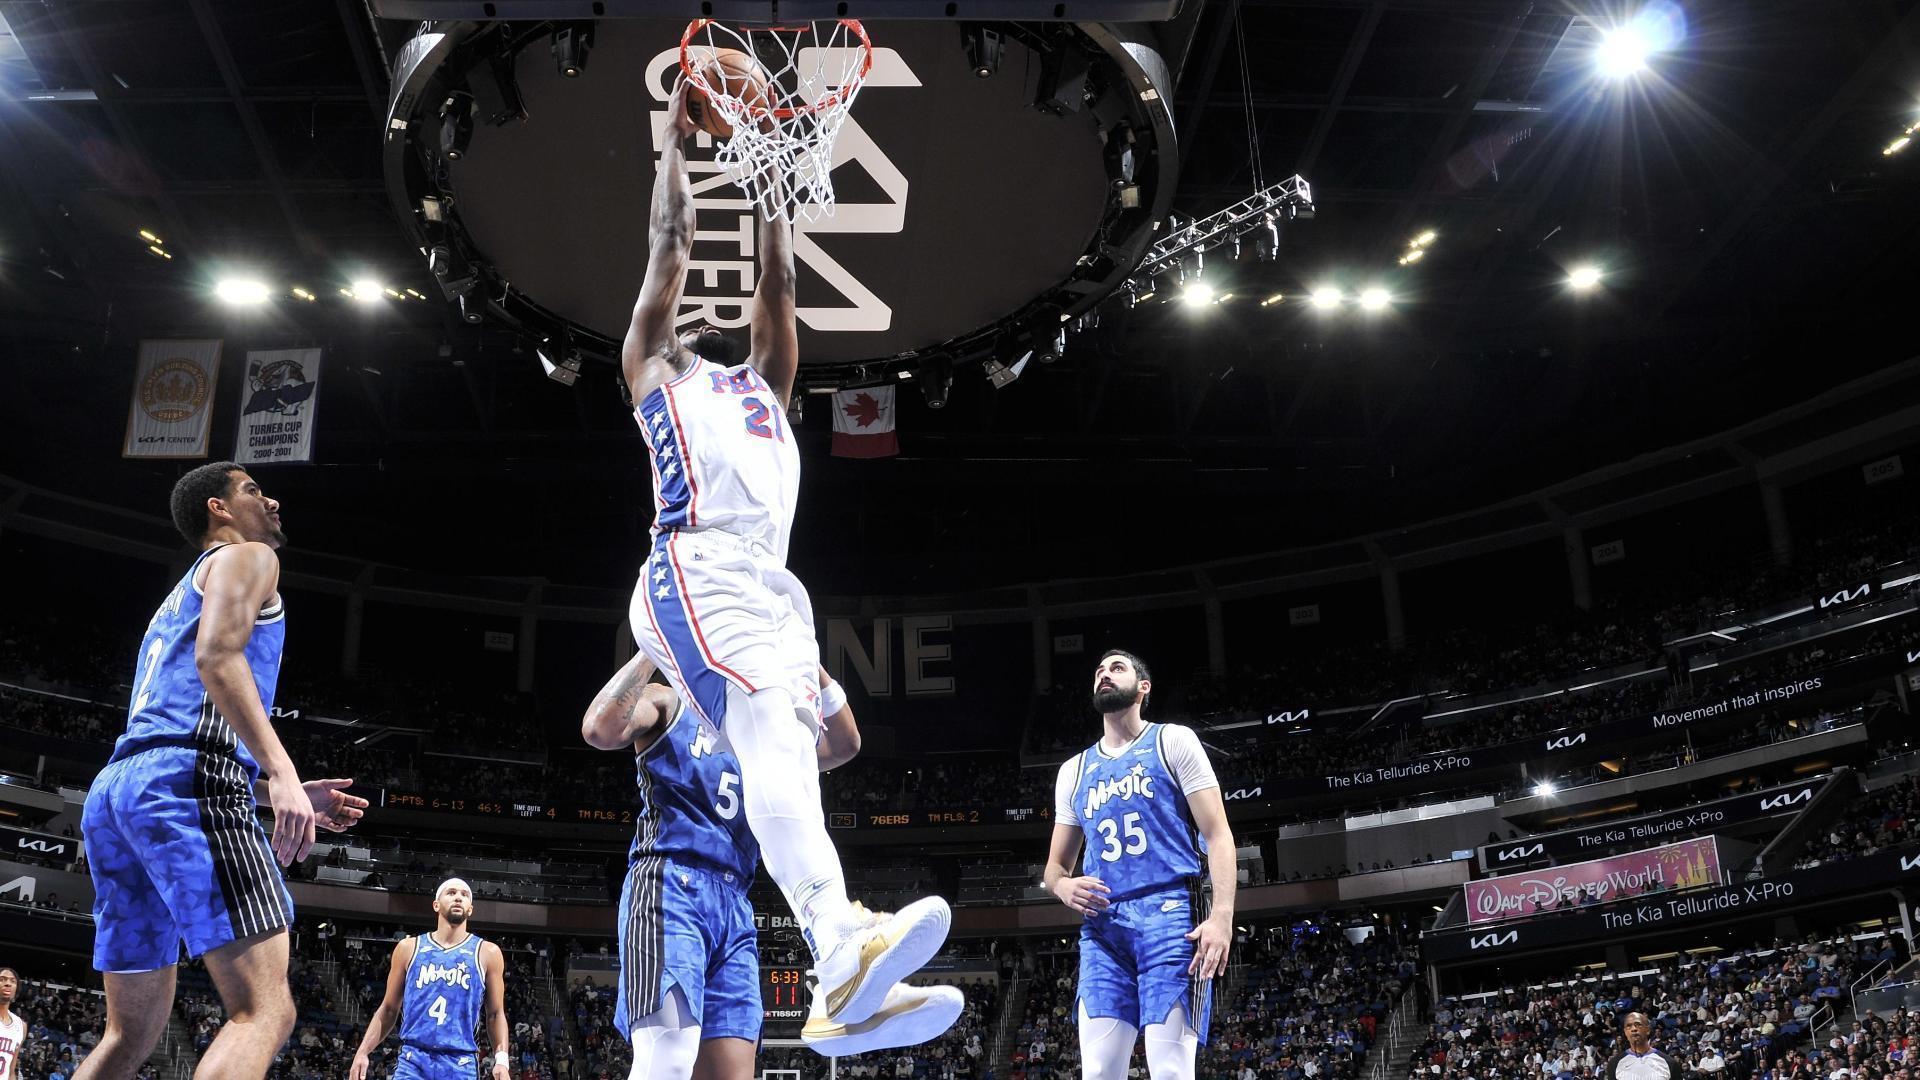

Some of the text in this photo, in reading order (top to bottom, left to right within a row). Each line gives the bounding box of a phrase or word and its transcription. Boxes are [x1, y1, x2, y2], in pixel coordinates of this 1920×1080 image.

[742, 397, 784, 443] 21
[249, 421, 302, 436] TURNER CUP
[167, 436, 196, 444] CENTER
[249, 433, 299, 447] CHAMPIONS
[253, 447, 292, 459] 2000-2001
[132, 637, 163, 719] 2
[1653, 677, 1822, 728] Movement that inspires
[1326, 756, 1470, 788] The Kia Telluride X-Pro
[389, 795, 424, 805] 3-PTS:
[513, 804, 526, 812] TIME
[547, 808, 555, 818] 4
[1040, 808, 1049, 819] 4
[578, 810, 631, 822] TM FLS: 2
[870, 815, 909, 825] 76ERS
[928, 810, 979, 822] TM FLS: 2
[1097, 812, 1147, 861] 35
[1578, 835, 1602, 848] The
[1605, 830, 1625, 843] Kia
[1629, 819, 1683, 838] Telluride
[1687, 811, 1724, 828] X-Pro
[1606, 863, 1665, 891] World
[1601, 912, 1632, 929] The
[1637, 905, 1662, 923] Kia
[1667, 892, 1739, 917] Telluride
[1744, 880, 1794, 905] X-Pro
[771, 971, 798, 984] 6:33
[428, 995, 447, 1025] 4
